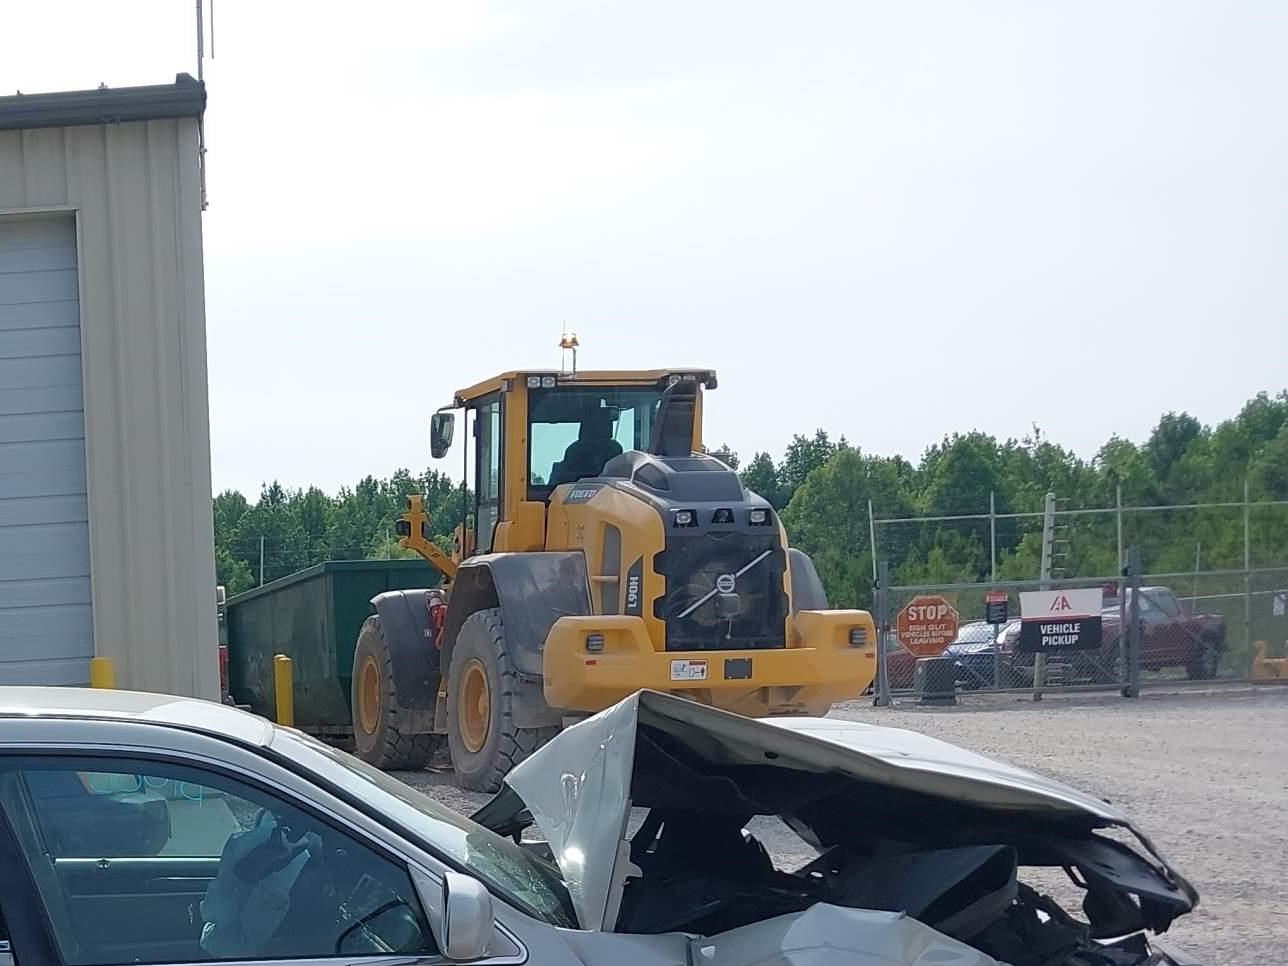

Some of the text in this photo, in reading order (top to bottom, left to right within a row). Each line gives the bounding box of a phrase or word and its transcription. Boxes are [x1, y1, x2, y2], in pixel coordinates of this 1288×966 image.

[627, 576, 640, 608] L90H
[908, 605, 948, 621] STOP
[1040, 623, 1081, 635] VEHICLE
[1042, 634, 1079, 647] PICKUP
